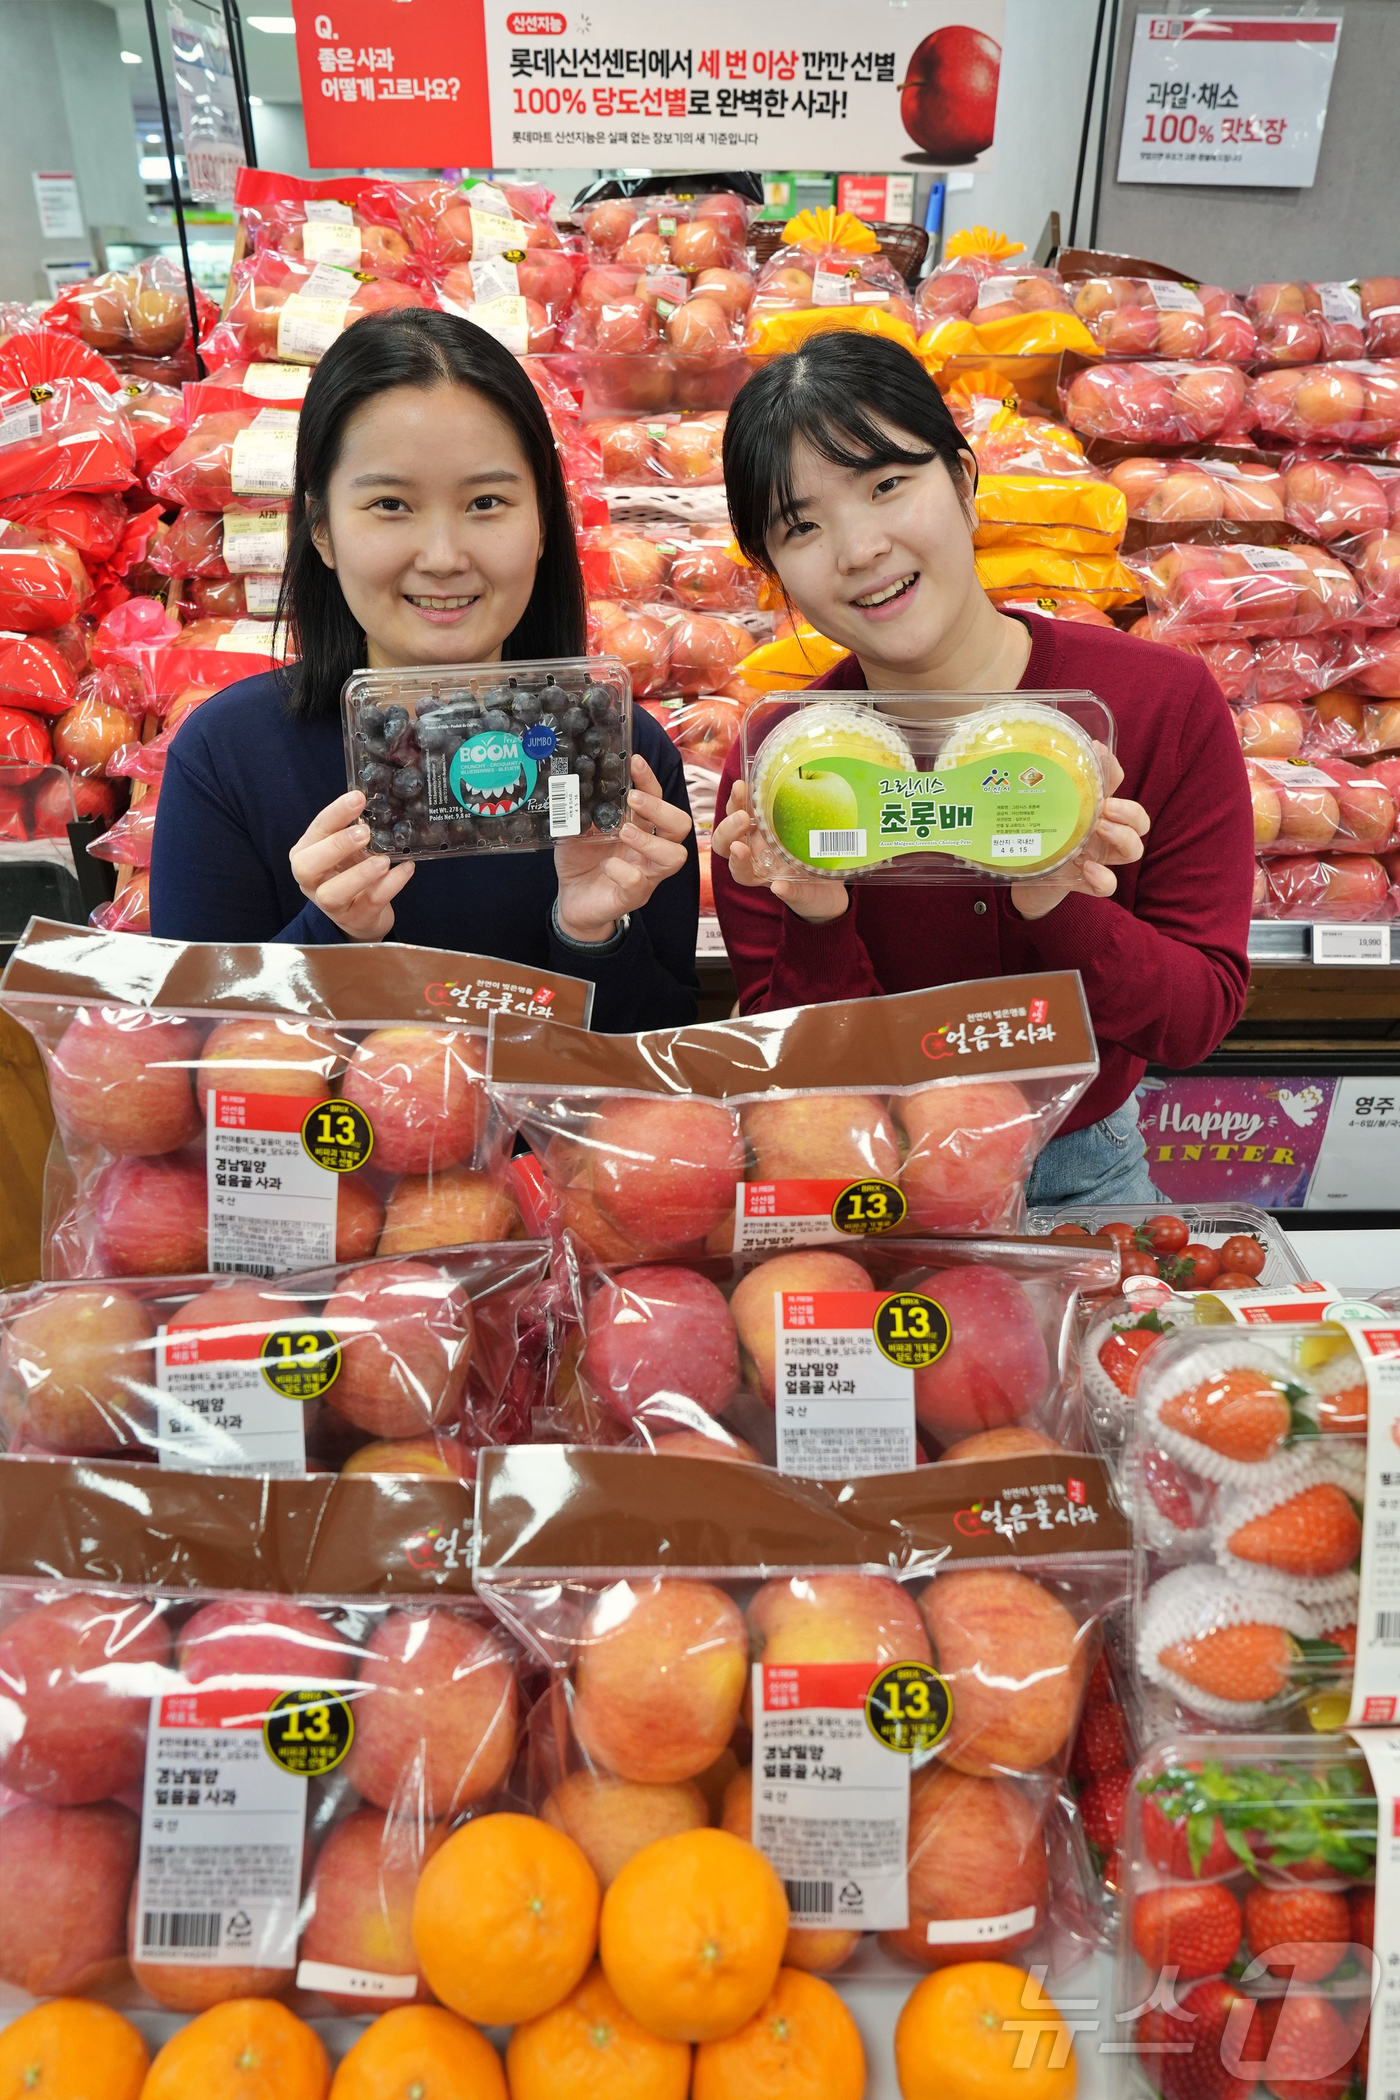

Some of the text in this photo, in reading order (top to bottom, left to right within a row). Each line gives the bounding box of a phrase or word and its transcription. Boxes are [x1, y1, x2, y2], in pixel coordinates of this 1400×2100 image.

[314, 15, 339, 41] Q.
[511, 15, 563, 33] 신선지능
[317, 47, 395, 73] 좋은 사과
[510, 48, 897, 83] 롯데신선센터에서 세 번 이상 깐깐 선별
[320, 77, 461, 102] 어떻게 고르나요?
[1146, 82, 1239, 110] 과일·채소
[513, 87, 848, 119] 100% 당도선별로 완벽한 사과!
[1142, 114, 1287, 145] 100% 맛보장
[512, 131, 759, 146] 롯데마트 신선지능은 실패 없는 장보기의 새 기준입니다
[527, 737, 552, 748] JUMBO
[460, 744, 518, 763] BOOM
[879, 777, 946, 799] 그린시스
[879, 801, 974, 838] 초롱배
[1359, 938, 1382, 946] 19,990
[220, 1105, 246, 1115] 신선을
[329, 1105, 350, 1113] BRIX
[1355, 1096, 1394, 1115] 영주
[220, 1115, 246, 1126] 새롭게
[1159, 1102, 1265, 1142] Happy
[317, 1114, 356, 1146] 13
[314, 1147, 360, 1160] 비파괴 기계로
[322, 1156, 354, 1168] 당도 선별
[1143, 1143, 1296, 1166] INTER
[215, 1157, 267, 1173] 경남밀양
[215, 1173, 282, 1190] 얼음골 사과
[861, 1184, 881, 1192] BRIX
[750, 1195, 775, 1205] 신선을
[847, 1193, 888, 1220] 13
[750, 1205, 775, 1214] 새롭게
[788, 1305, 814, 1315] 신선을
[788, 1315, 815, 1325] 새롭게
[889, 1306, 931, 1338] 13
[276, 1335, 319, 1370] 13
[888, 1343, 937, 1352] 비파괴 기계로
[896, 1353, 930, 1362] 당도 선별
[785, 1363, 838, 1377] 경남밀양
[785, 1380, 855, 1394] 얼음골 사과
[214, 1415, 243, 1430] 사과
[883, 1681, 930, 1720] 13
[281, 1703, 331, 1742] 13
